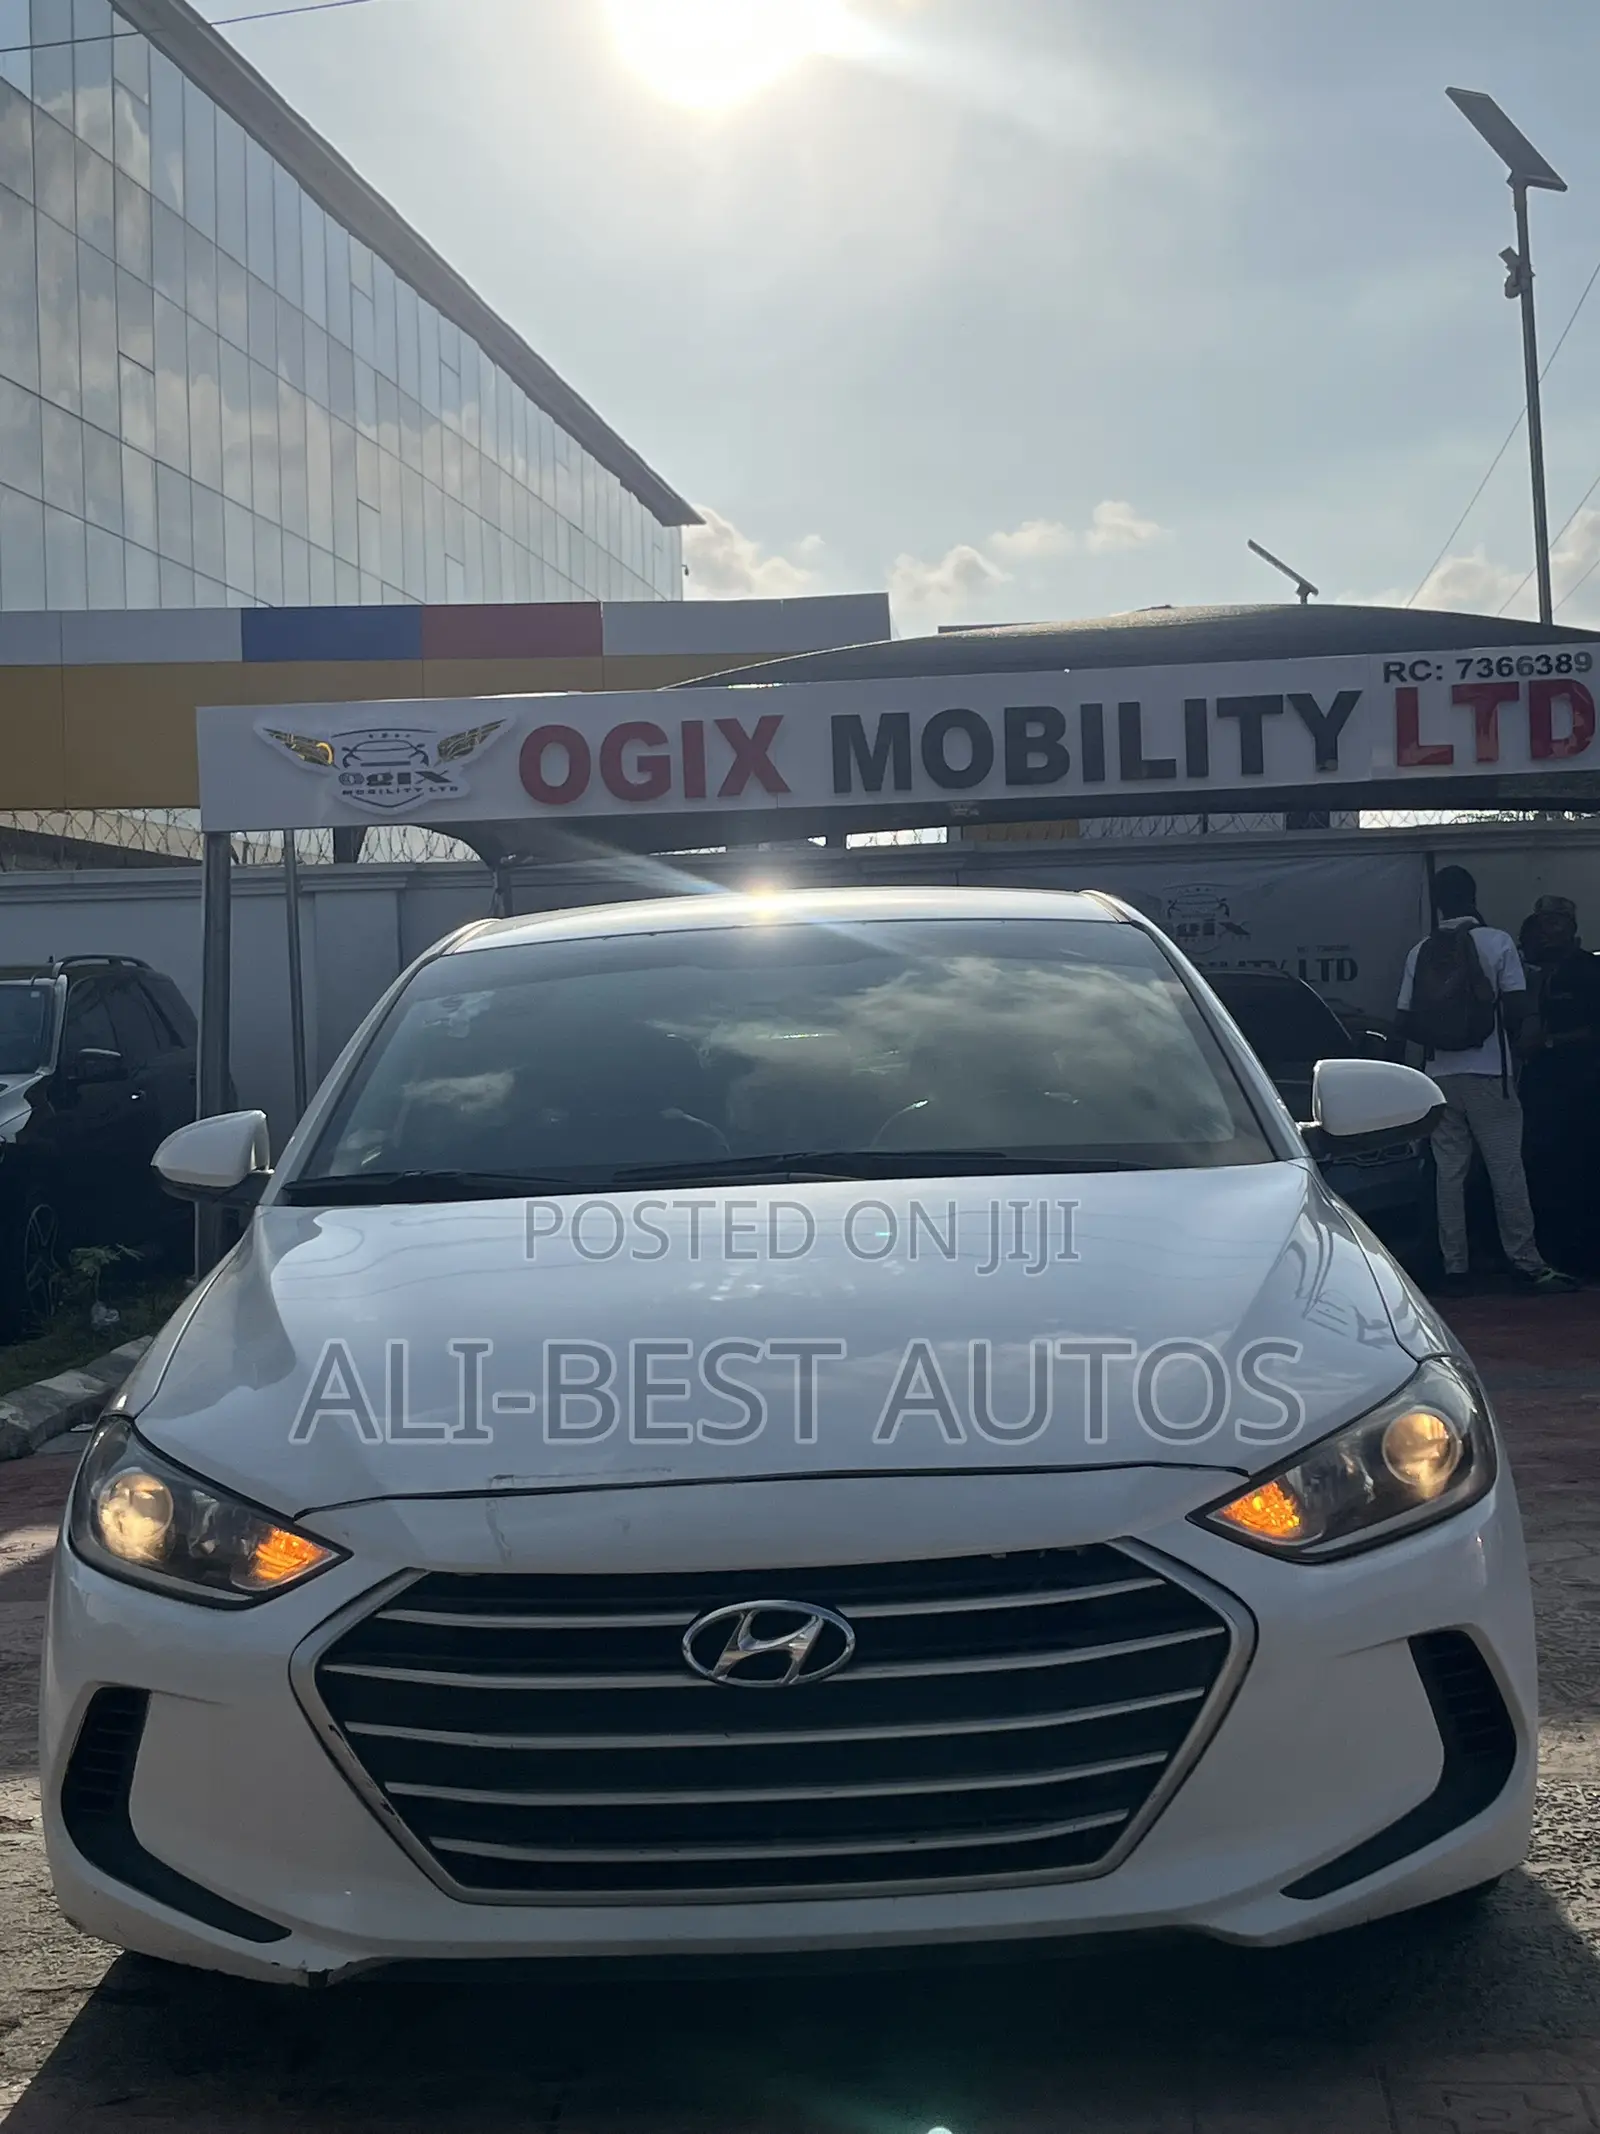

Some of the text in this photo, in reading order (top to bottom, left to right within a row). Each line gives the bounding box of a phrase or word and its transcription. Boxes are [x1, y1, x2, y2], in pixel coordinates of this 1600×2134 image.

[1383, 651, 1593, 683] RC: 7366389
[518, 678, 1596, 805] OGIX MOBILITY LTD
[342, 787, 424, 796] MOBILITY
[1298, 958, 1359, 982] LTD
